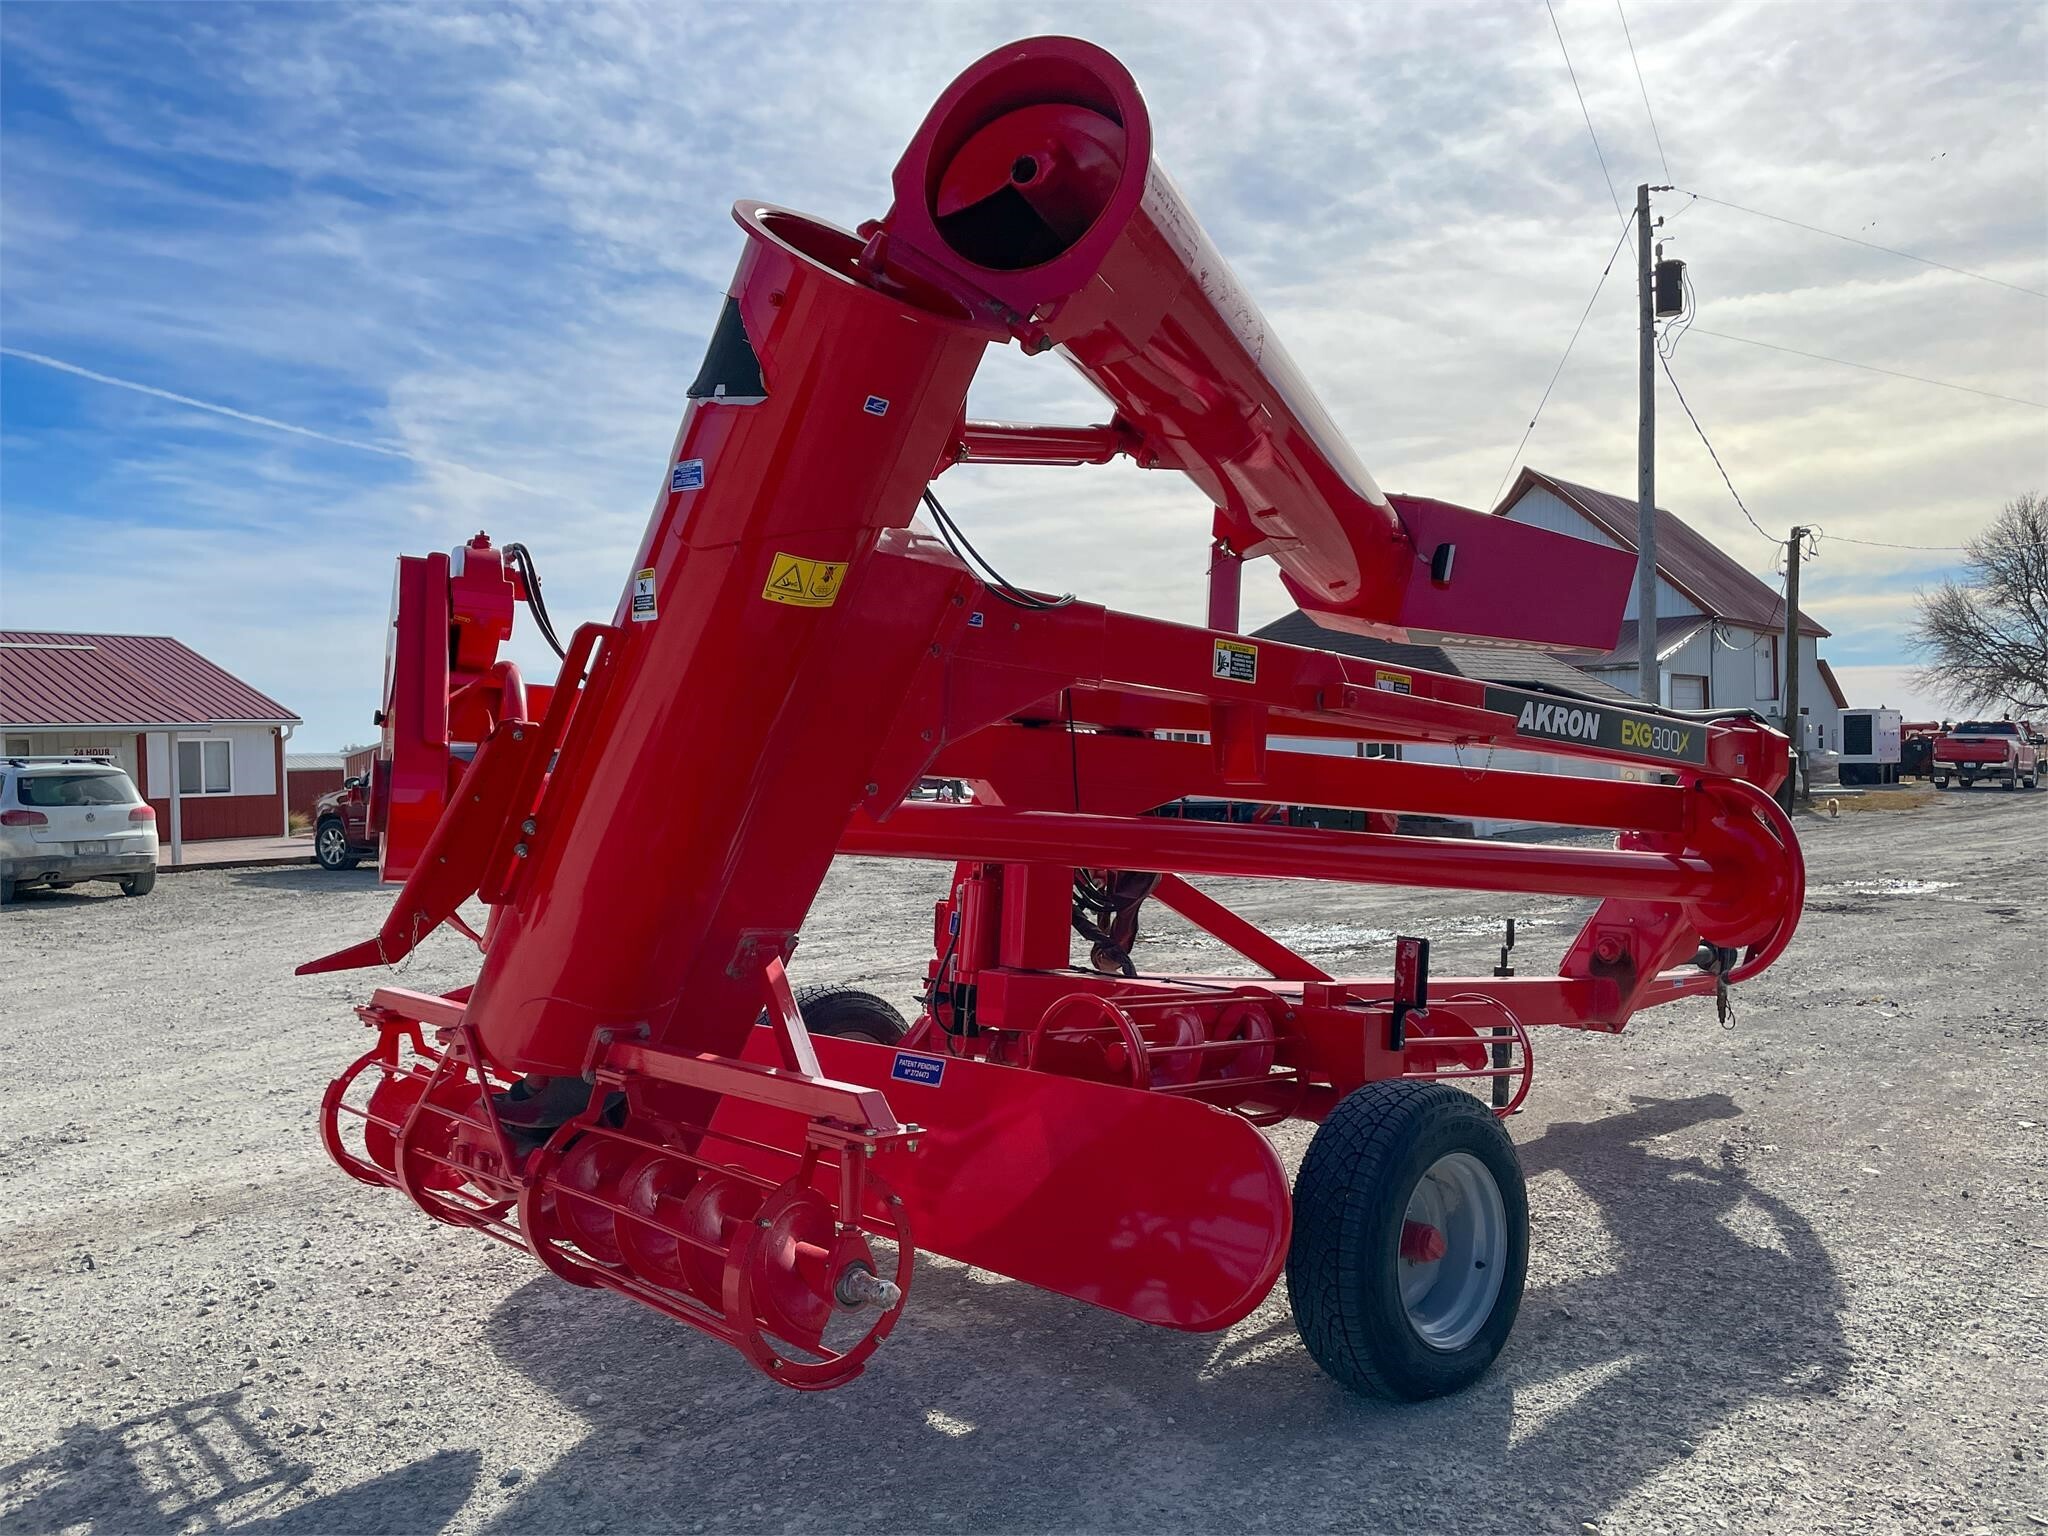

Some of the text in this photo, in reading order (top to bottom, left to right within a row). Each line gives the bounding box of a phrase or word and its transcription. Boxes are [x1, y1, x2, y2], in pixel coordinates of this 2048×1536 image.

[1517, 700, 1601, 741] AKRON
[73, 748, 110, 756] 24 HOUR
[899, 1058, 940, 1072] PATENT PENDING
